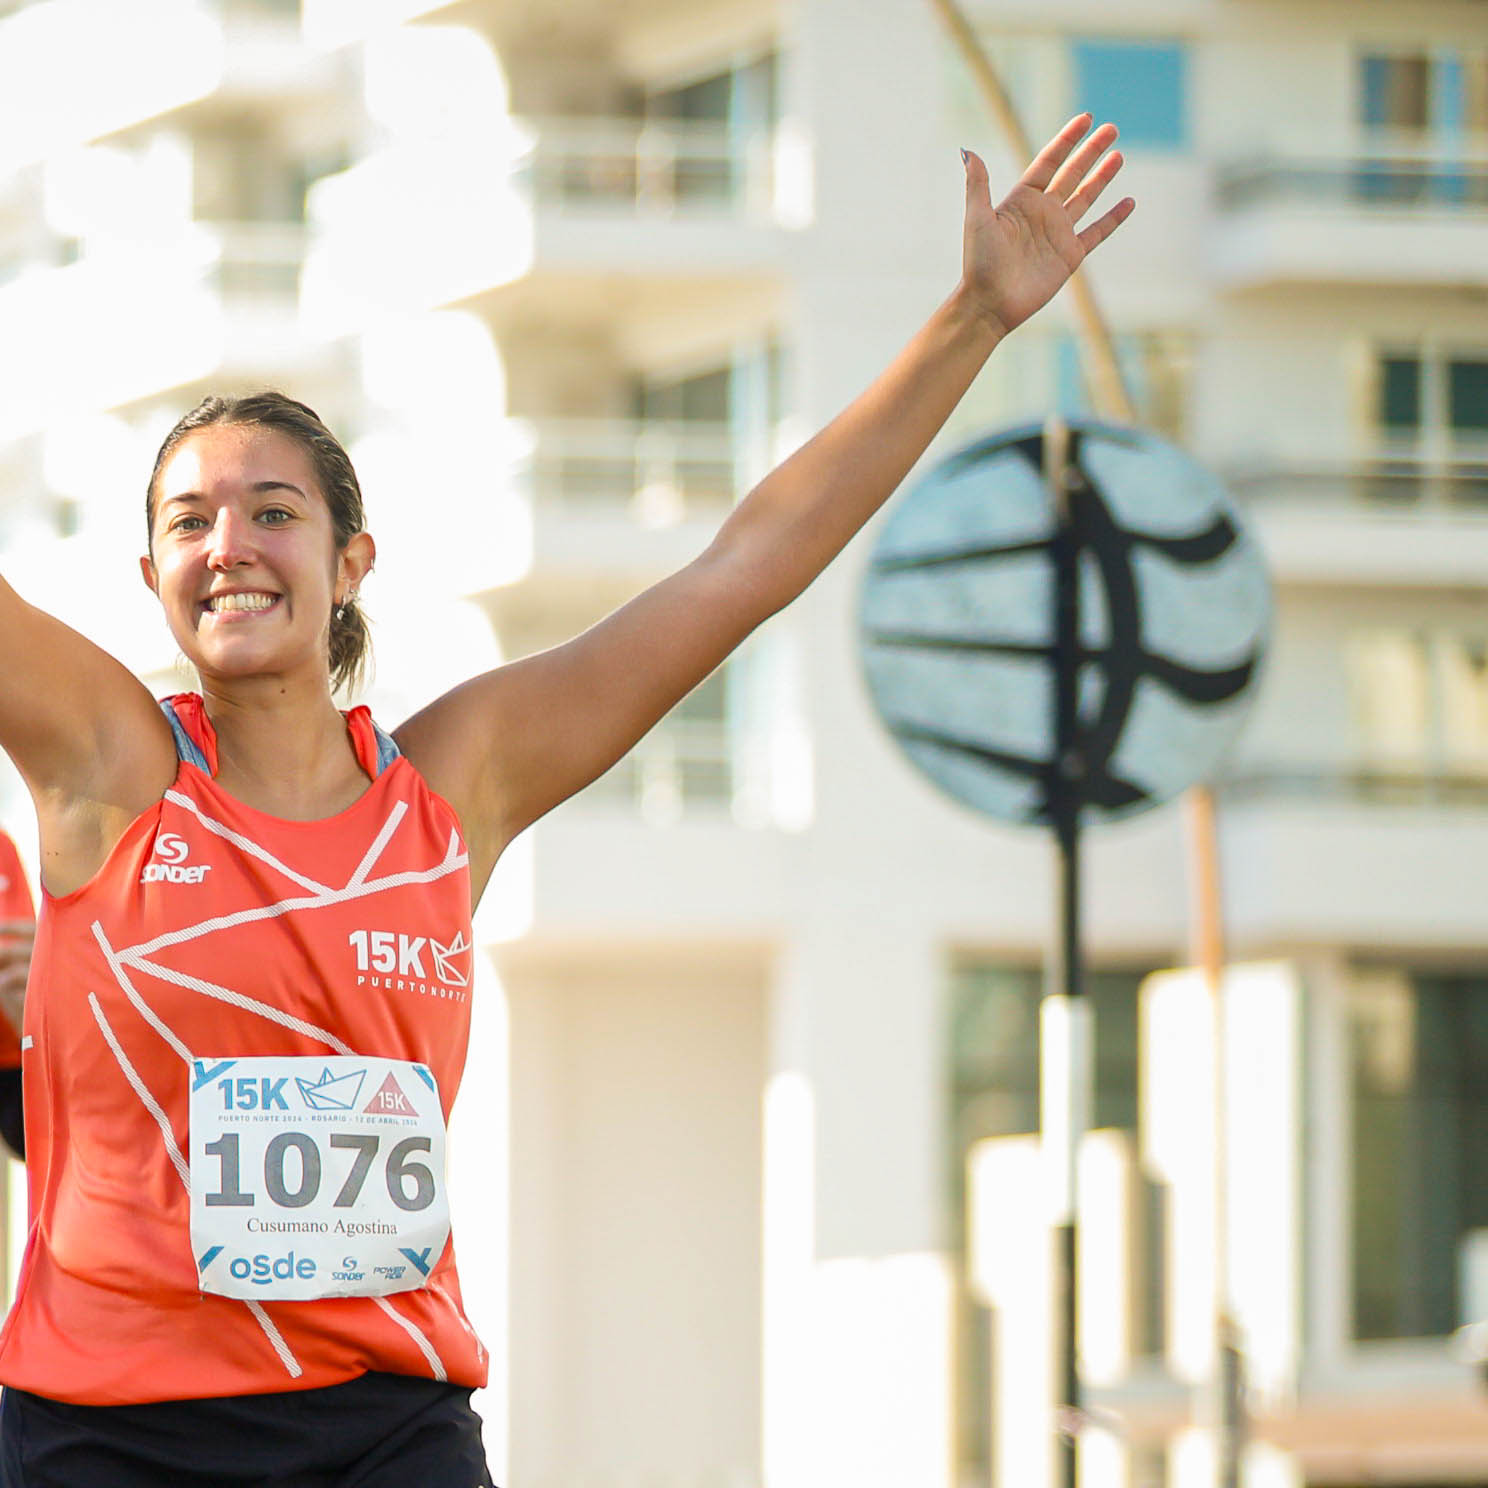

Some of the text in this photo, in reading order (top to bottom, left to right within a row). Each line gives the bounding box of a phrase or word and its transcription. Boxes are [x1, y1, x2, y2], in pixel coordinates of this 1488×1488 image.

[349, 929, 427, 979] 15K
[357, 975, 426, 995] PUERTO
[218, 1077, 289, 1110] 15K
[378, 1090, 407, 1111] 15K
[205, 1132, 436, 1212] 1076
[247, 1218, 398, 1238] Cusumano Agostina
[230, 1251, 317, 1285] osde
